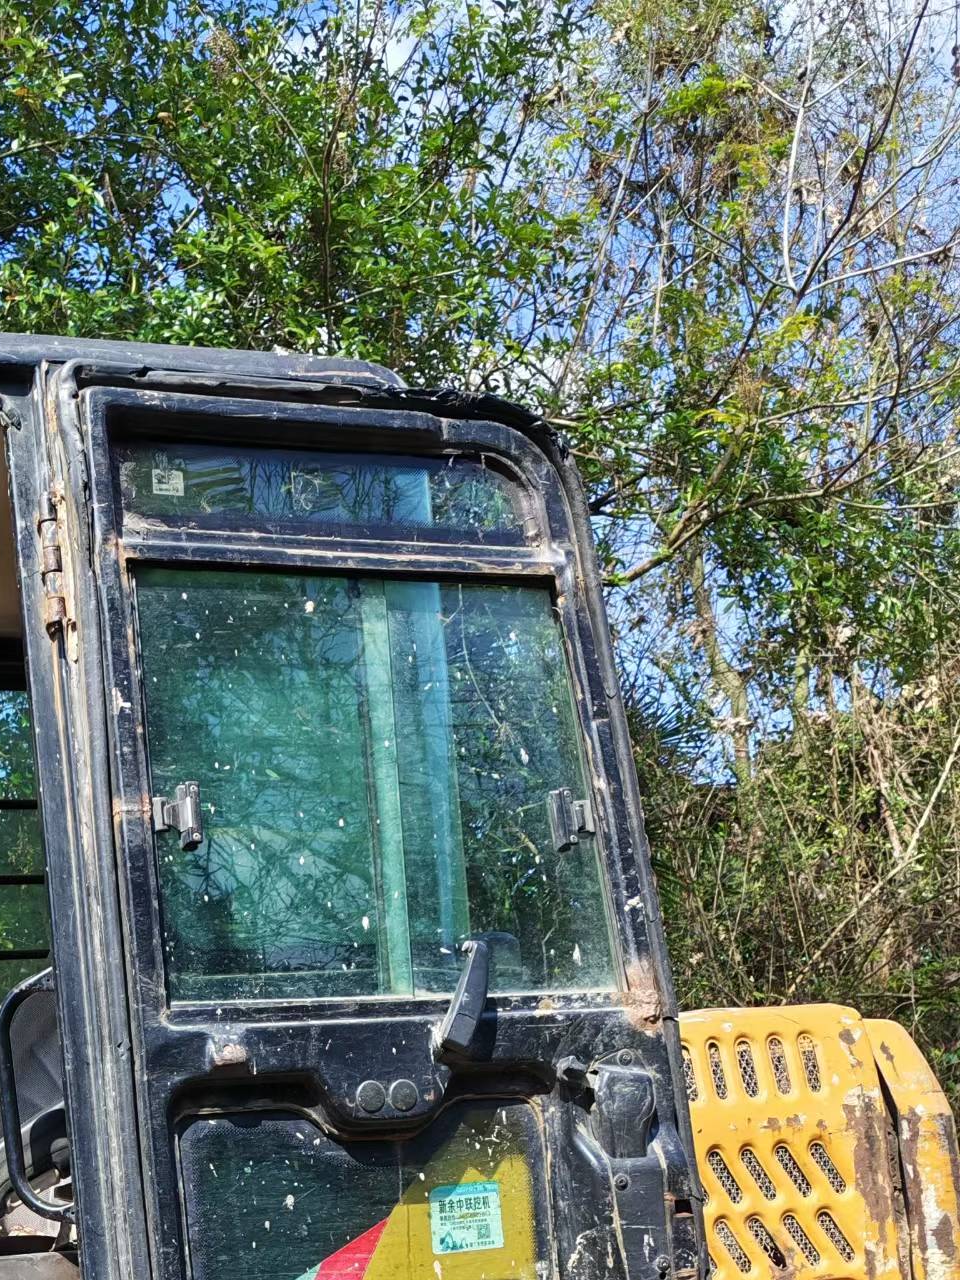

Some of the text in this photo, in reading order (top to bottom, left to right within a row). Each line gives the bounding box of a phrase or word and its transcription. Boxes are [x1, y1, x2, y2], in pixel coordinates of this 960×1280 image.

[438, 1196, 491, 1214] 新余中联挖机
